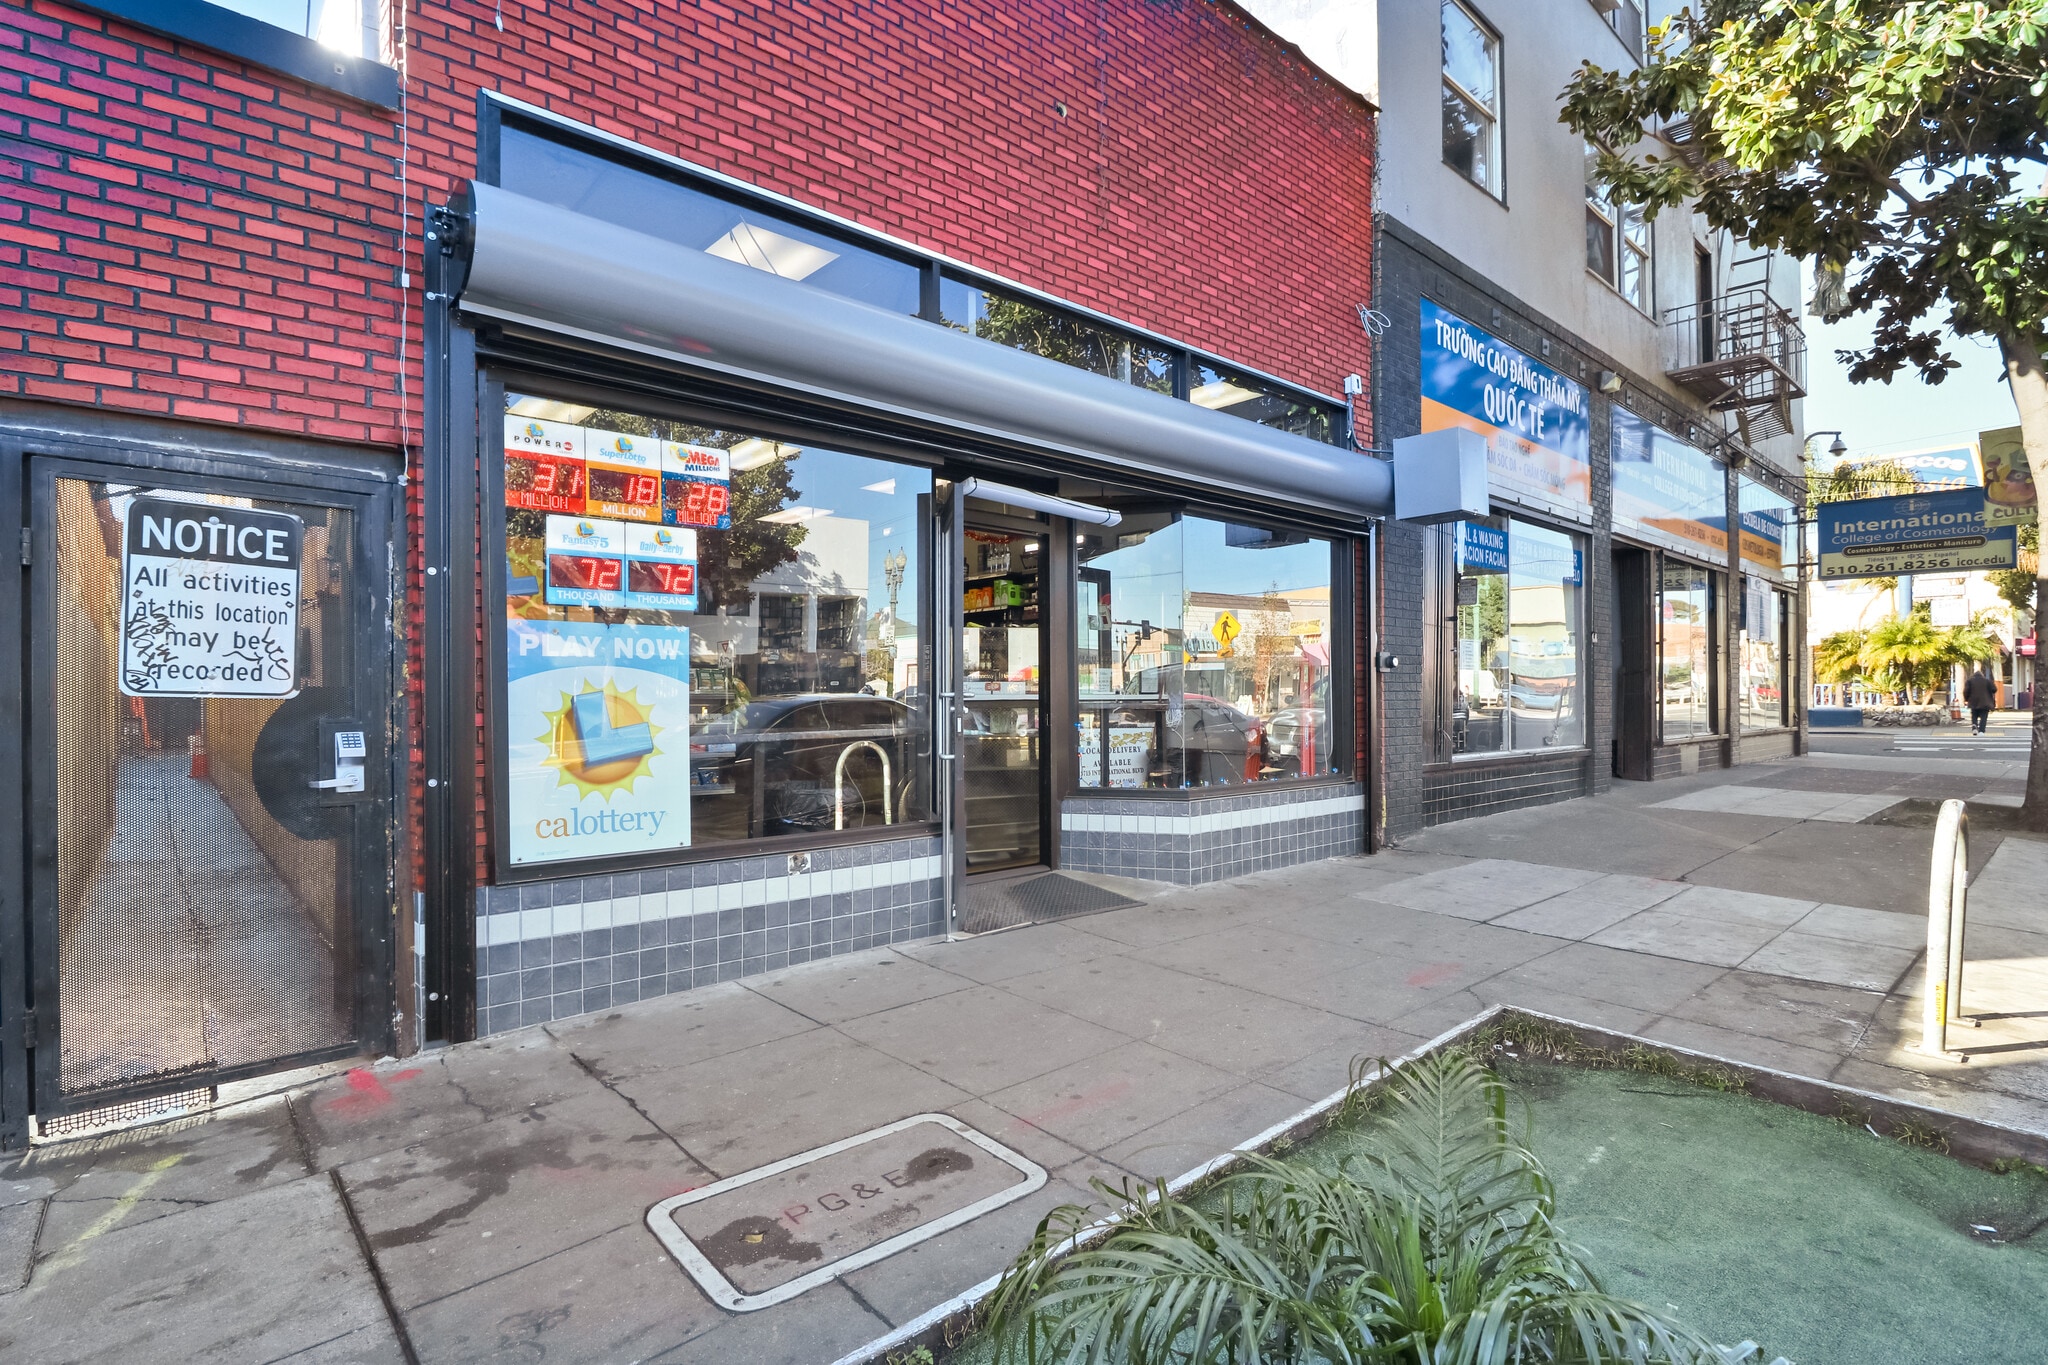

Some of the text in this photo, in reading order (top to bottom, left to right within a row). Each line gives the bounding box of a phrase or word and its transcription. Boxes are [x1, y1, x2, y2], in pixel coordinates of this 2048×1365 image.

[1435, 318, 1485, 367] TRƯỜNG
[1486, 348, 1508, 379] CAO
[1483, 383, 1545, 440] QUỐC TẾ
[514, 435, 562, 448] POWER
[599, 448, 647, 462] SuperLotto
[686, 450, 720, 466] MEGA
[684, 464, 720, 472] MILLIONS
[534, 463, 581, 495] 31
[626, 476, 657, 504] 18
[687, 483, 726, 512] 28
[520, 491, 569, 510] MILLION
[602, 503, 647, 518] MILLION
[677, 509, 718, 526] MILLION
[1834, 512, 1985, 534] Internationa
[142, 515, 289, 562] NOTICE
[562, 534, 609, 548] Fantasy 5
[1472, 528, 1478, 543] &
[1478, 530, 1504, 549] WAXING
[1832, 524, 1998, 545] College of Cosmetology
[640, 541, 657, 553] Daily
[1846, 545, 1895, 554] Cosmetology
[1943, 539, 1981, 547] Manicure
[1485, 549, 1507, 568] FACIAL
[1827, 555, 2006, 575] 510.261.8256 icoc.edu
[134, 566, 291, 597] All activities
[580, 558, 620, 588] 72
[657, 564, 693, 592] 72
[556, 590, 615, 601] THOUSAND
[636, 594, 689, 606] THOUSAND
[136, 598, 288, 625] at this location
[166, 631, 260, 653] may be
[519, 633, 681, 660] PLAY NOW
[155, 662, 263, 682] recorded
[1108, 746, 1141, 754] DELIVERY
[1093, 759, 1131, 767] AVLABLE
[535, 807, 666, 839] calottery
[784, 1169, 912, 1225] PG&E
